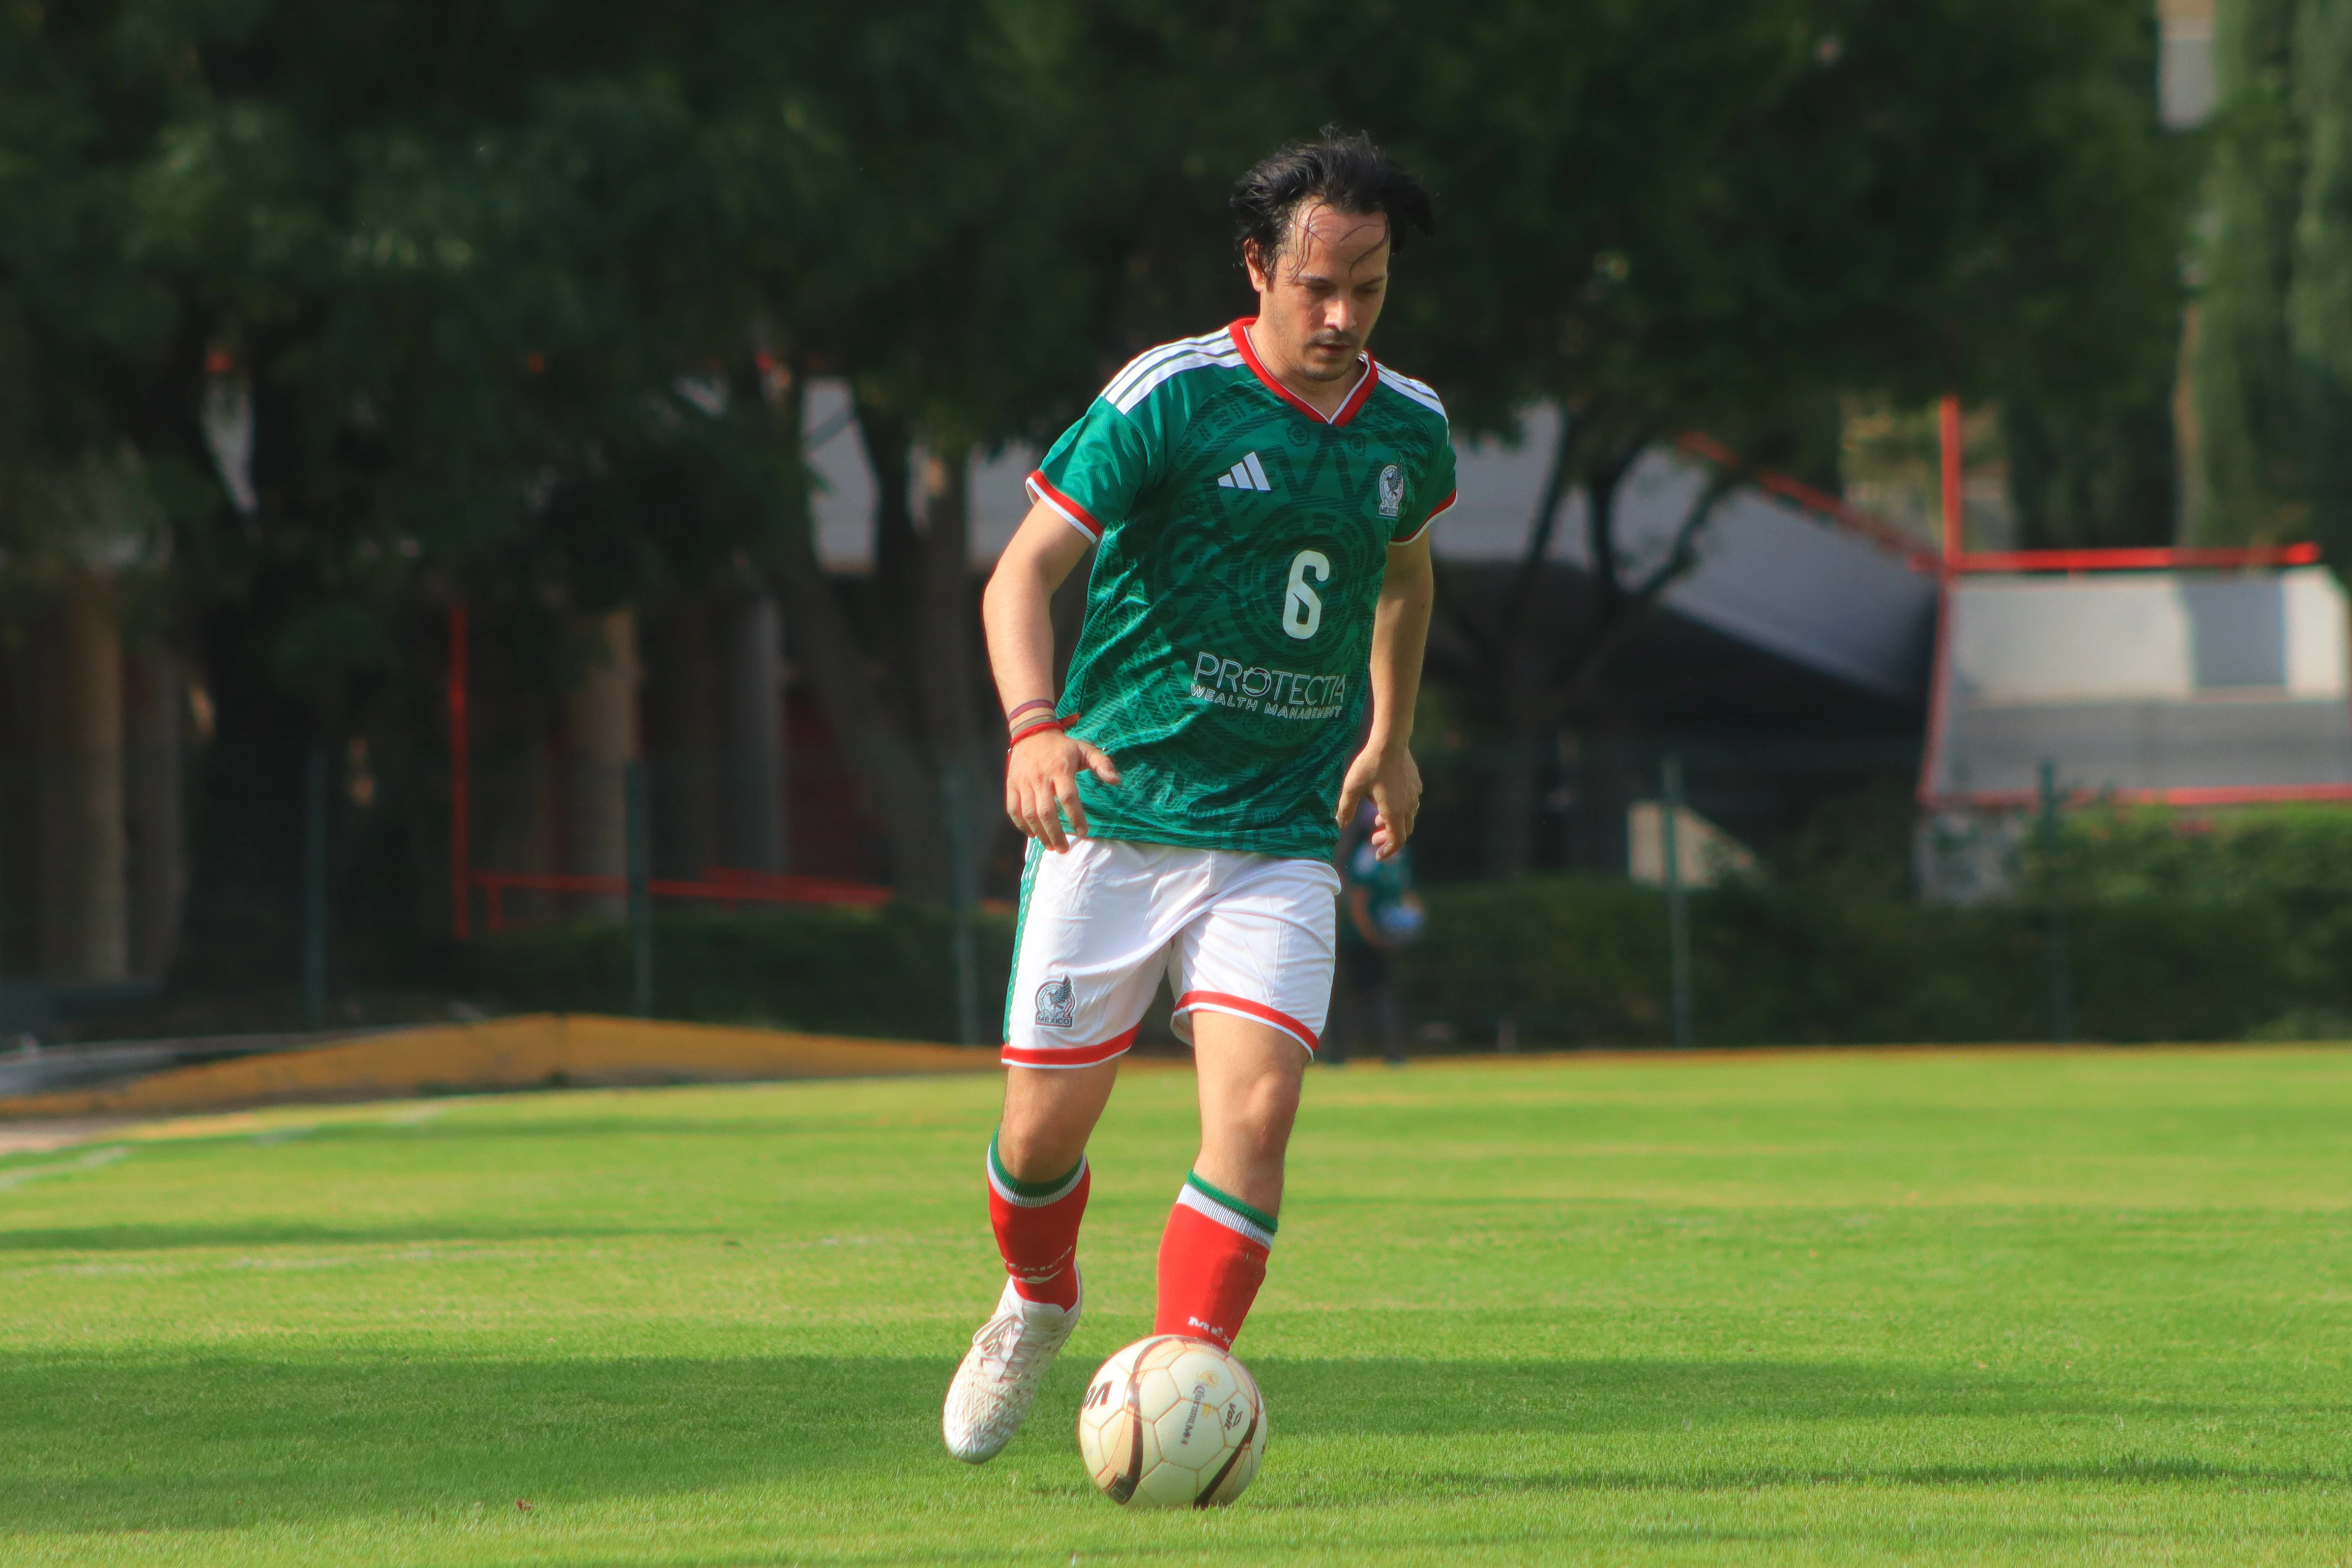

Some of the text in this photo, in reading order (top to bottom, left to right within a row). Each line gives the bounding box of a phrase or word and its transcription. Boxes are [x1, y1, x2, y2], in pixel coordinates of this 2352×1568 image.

[1282, 550, 1330, 639] 6
[1191, 683, 1342, 719] WEALTH MANAGEMENT
